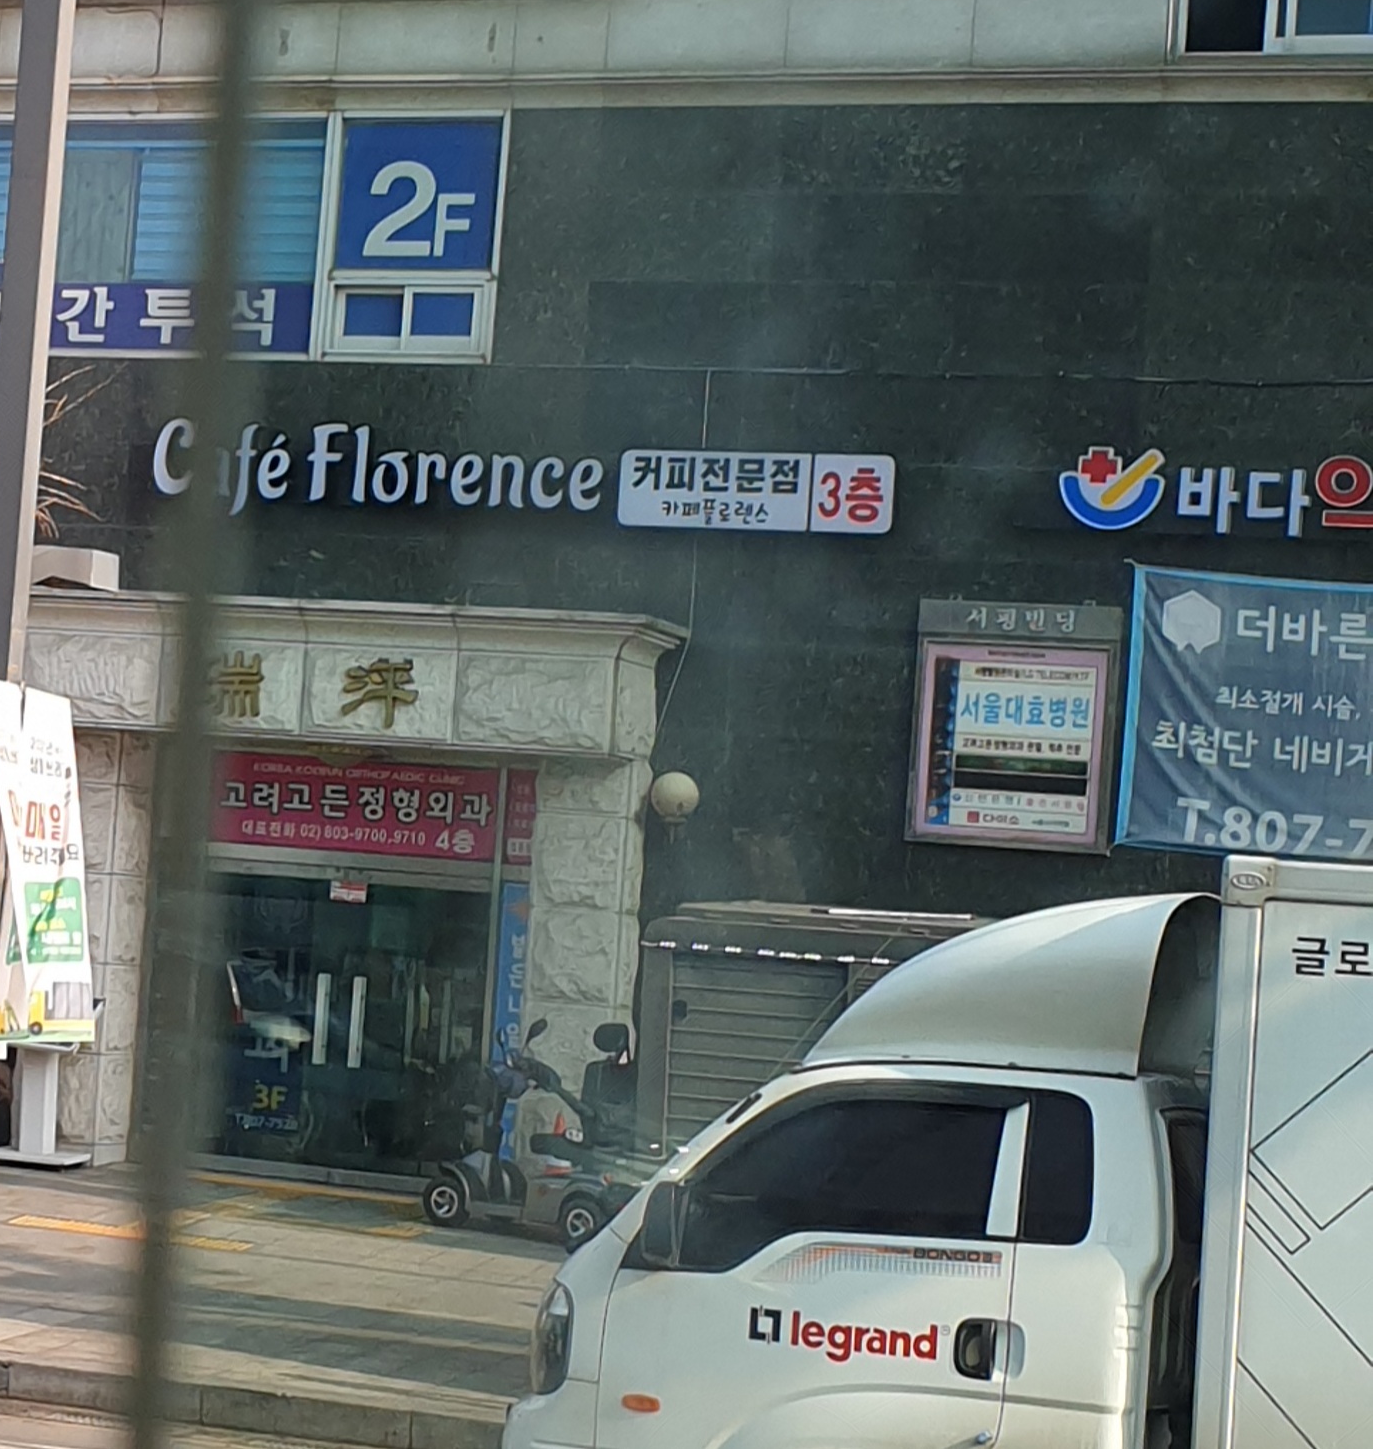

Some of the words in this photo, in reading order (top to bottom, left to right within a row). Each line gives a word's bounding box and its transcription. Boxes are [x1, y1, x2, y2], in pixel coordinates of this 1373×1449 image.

[361, 160, 477, 258] 2F
[153, 418, 291, 516] Cfé
[307, 422, 604, 512] Florence
[630, 455, 801, 494] 커피전문점
[661, 498, 770, 526] 카페플로렌스
[818, 467, 884, 523] 3층
[1237, 605, 1373, 661] 더바른
[960, 691, 1091, 729] 서울대효병원
[1152, 720, 1259, 769] 최첨단
[220, 780, 492, 827] 고려고든정형외과
[433, 828, 476, 855] 4층
[1291, 937, 1373, 977] 글로
[252, 1083, 288, 1111] 3F
[789, 1309, 939, 1363] legrand
